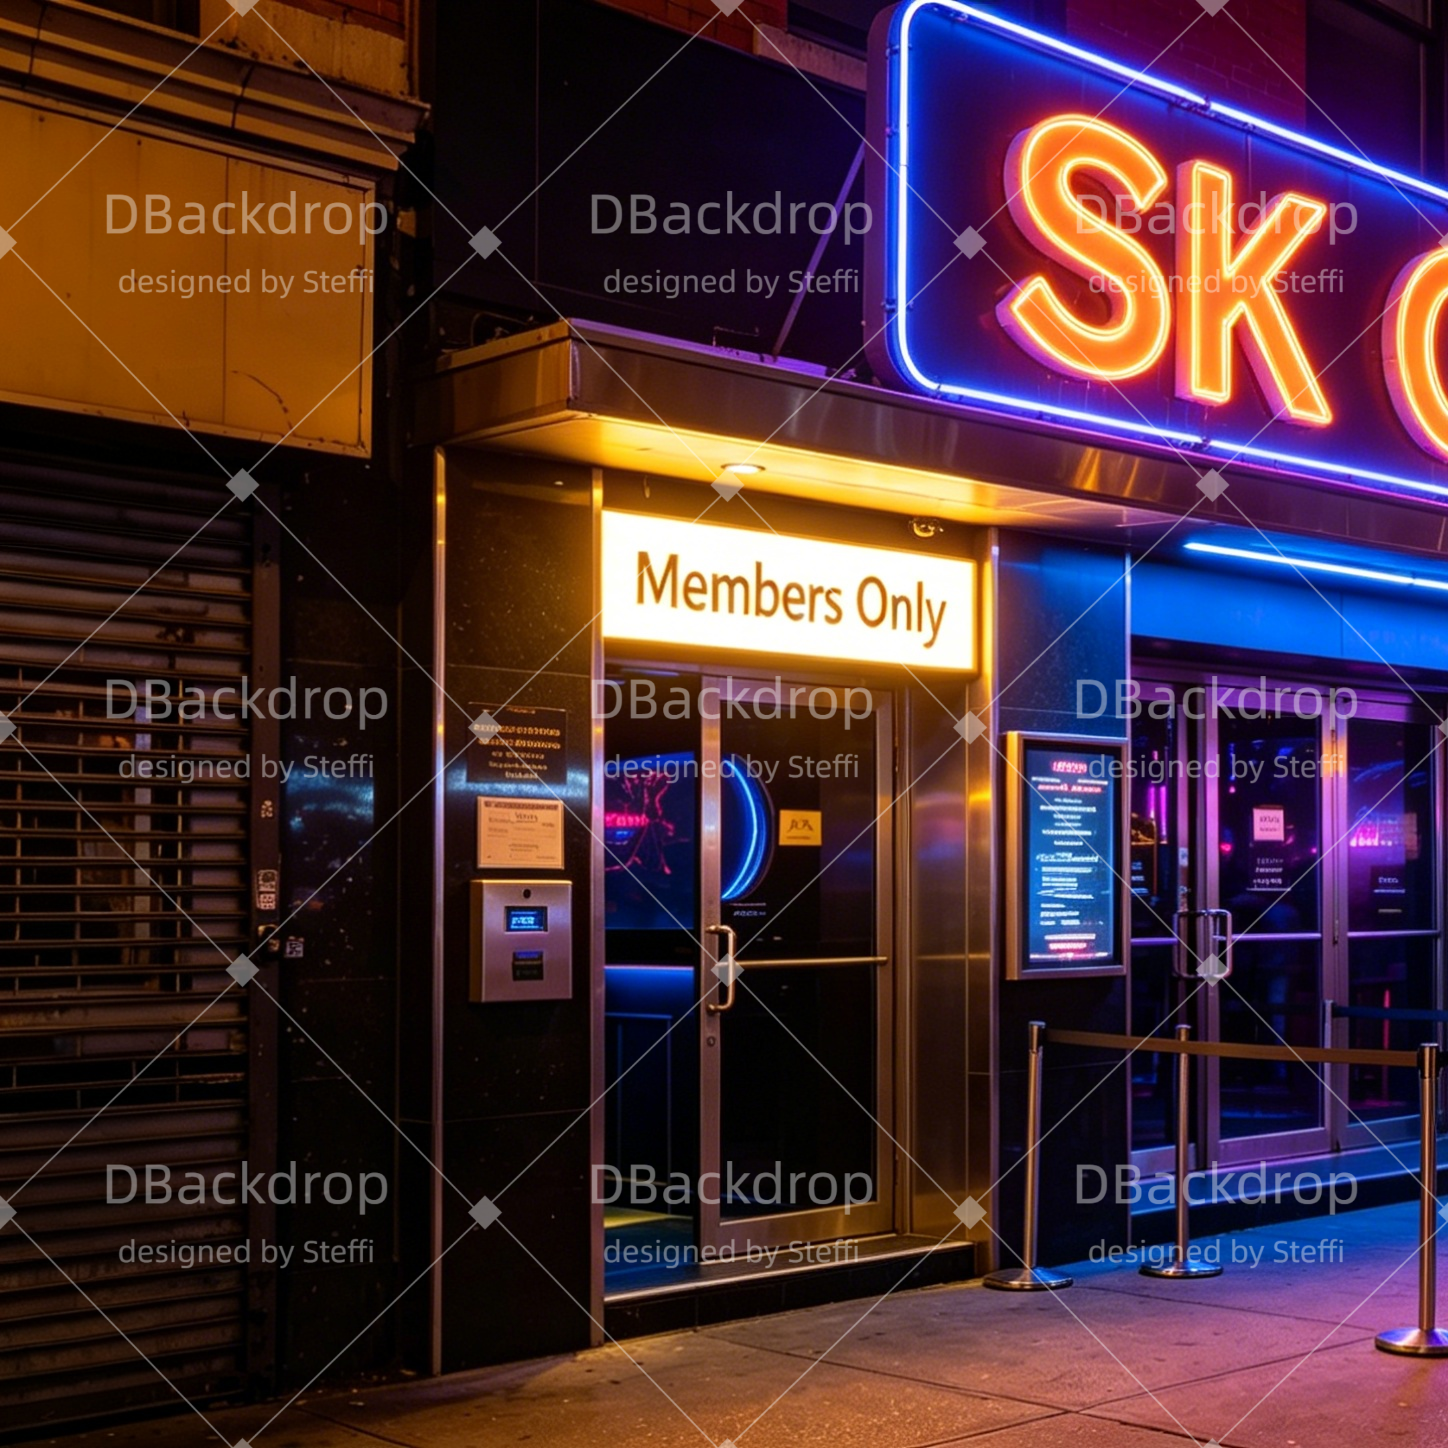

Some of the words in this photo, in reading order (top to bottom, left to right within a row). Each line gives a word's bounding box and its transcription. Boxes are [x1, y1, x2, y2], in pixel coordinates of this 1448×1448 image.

[996, 114, 1332, 427] SK
[636, 550, 843, 625] Members
[856, 575, 947, 649] Only
